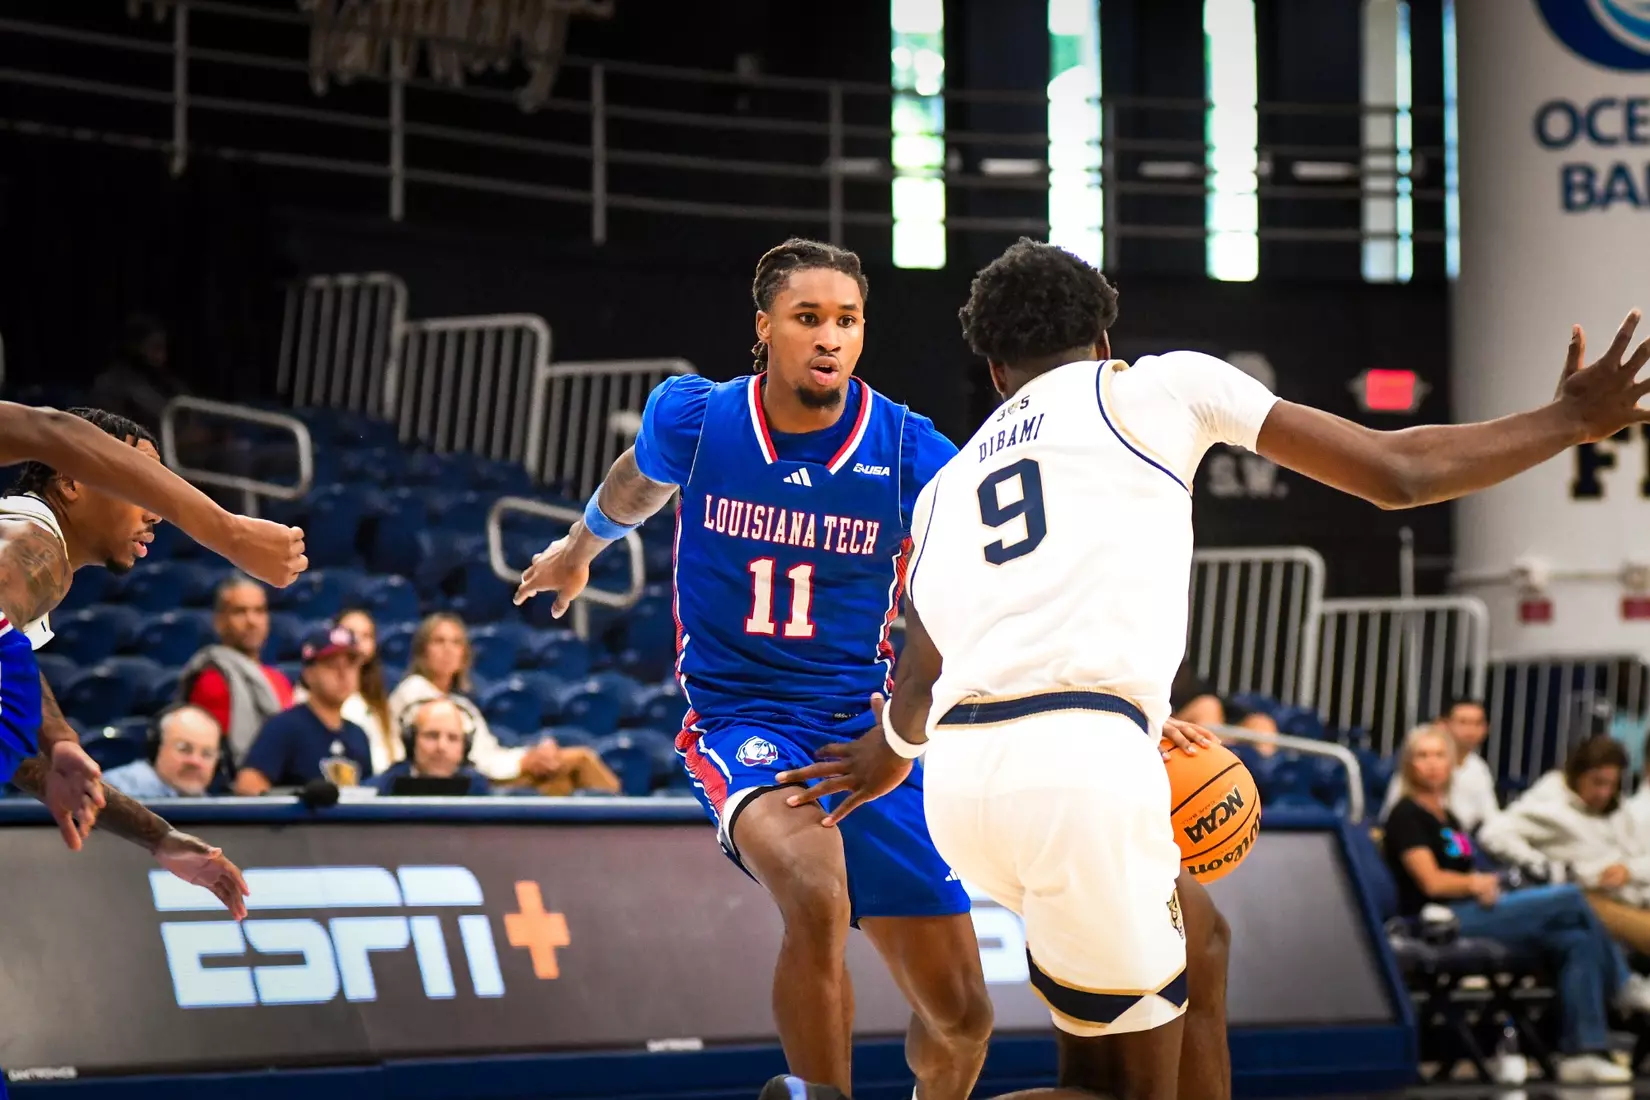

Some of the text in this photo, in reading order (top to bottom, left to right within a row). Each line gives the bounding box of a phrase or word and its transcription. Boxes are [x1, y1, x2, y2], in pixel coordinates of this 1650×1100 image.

[1560, 162, 1650, 213] BA
[978, 412, 1045, 463] DIBAMI
[703, 494, 880, 556] LOUISIANA TECH
[976, 457, 1048, 566] 9
[743, 555, 817, 640] 11
[1184, 785, 1244, 844] NCAA
